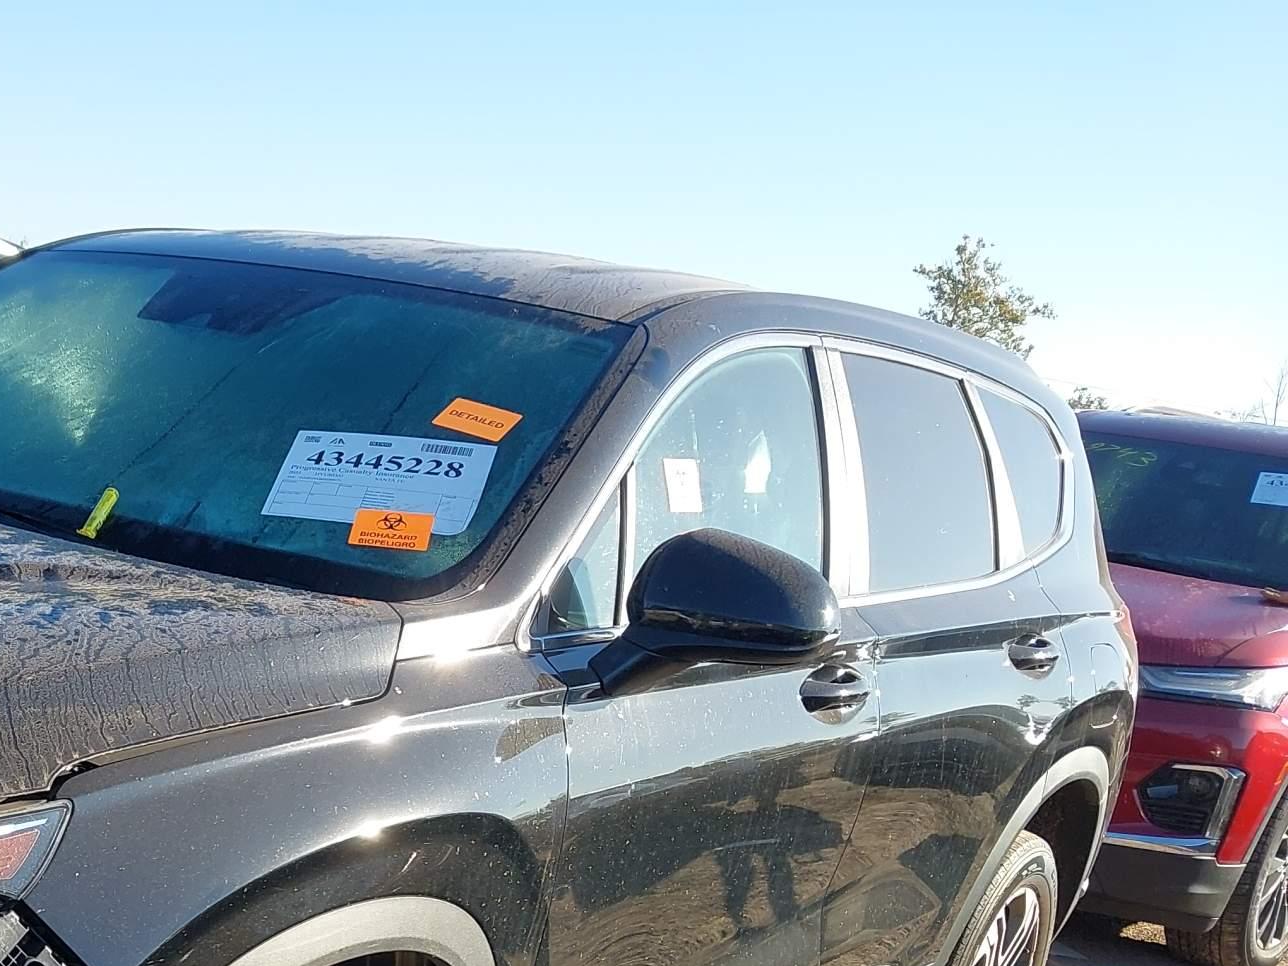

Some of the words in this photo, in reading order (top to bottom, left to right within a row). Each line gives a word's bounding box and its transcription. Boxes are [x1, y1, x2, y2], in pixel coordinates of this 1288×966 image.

[449, 409, 505, 429] DETAILED
[291, 463, 337, 474] Progressive
[339, 467, 373, 476] Casualty
[375, 470, 415, 479] Insurance
[306, 449, 465, 479] 43445228
[358, 537, 417, 549] BIOPELIGRO
[360, 530, 418, 541] BIOHAZARD
